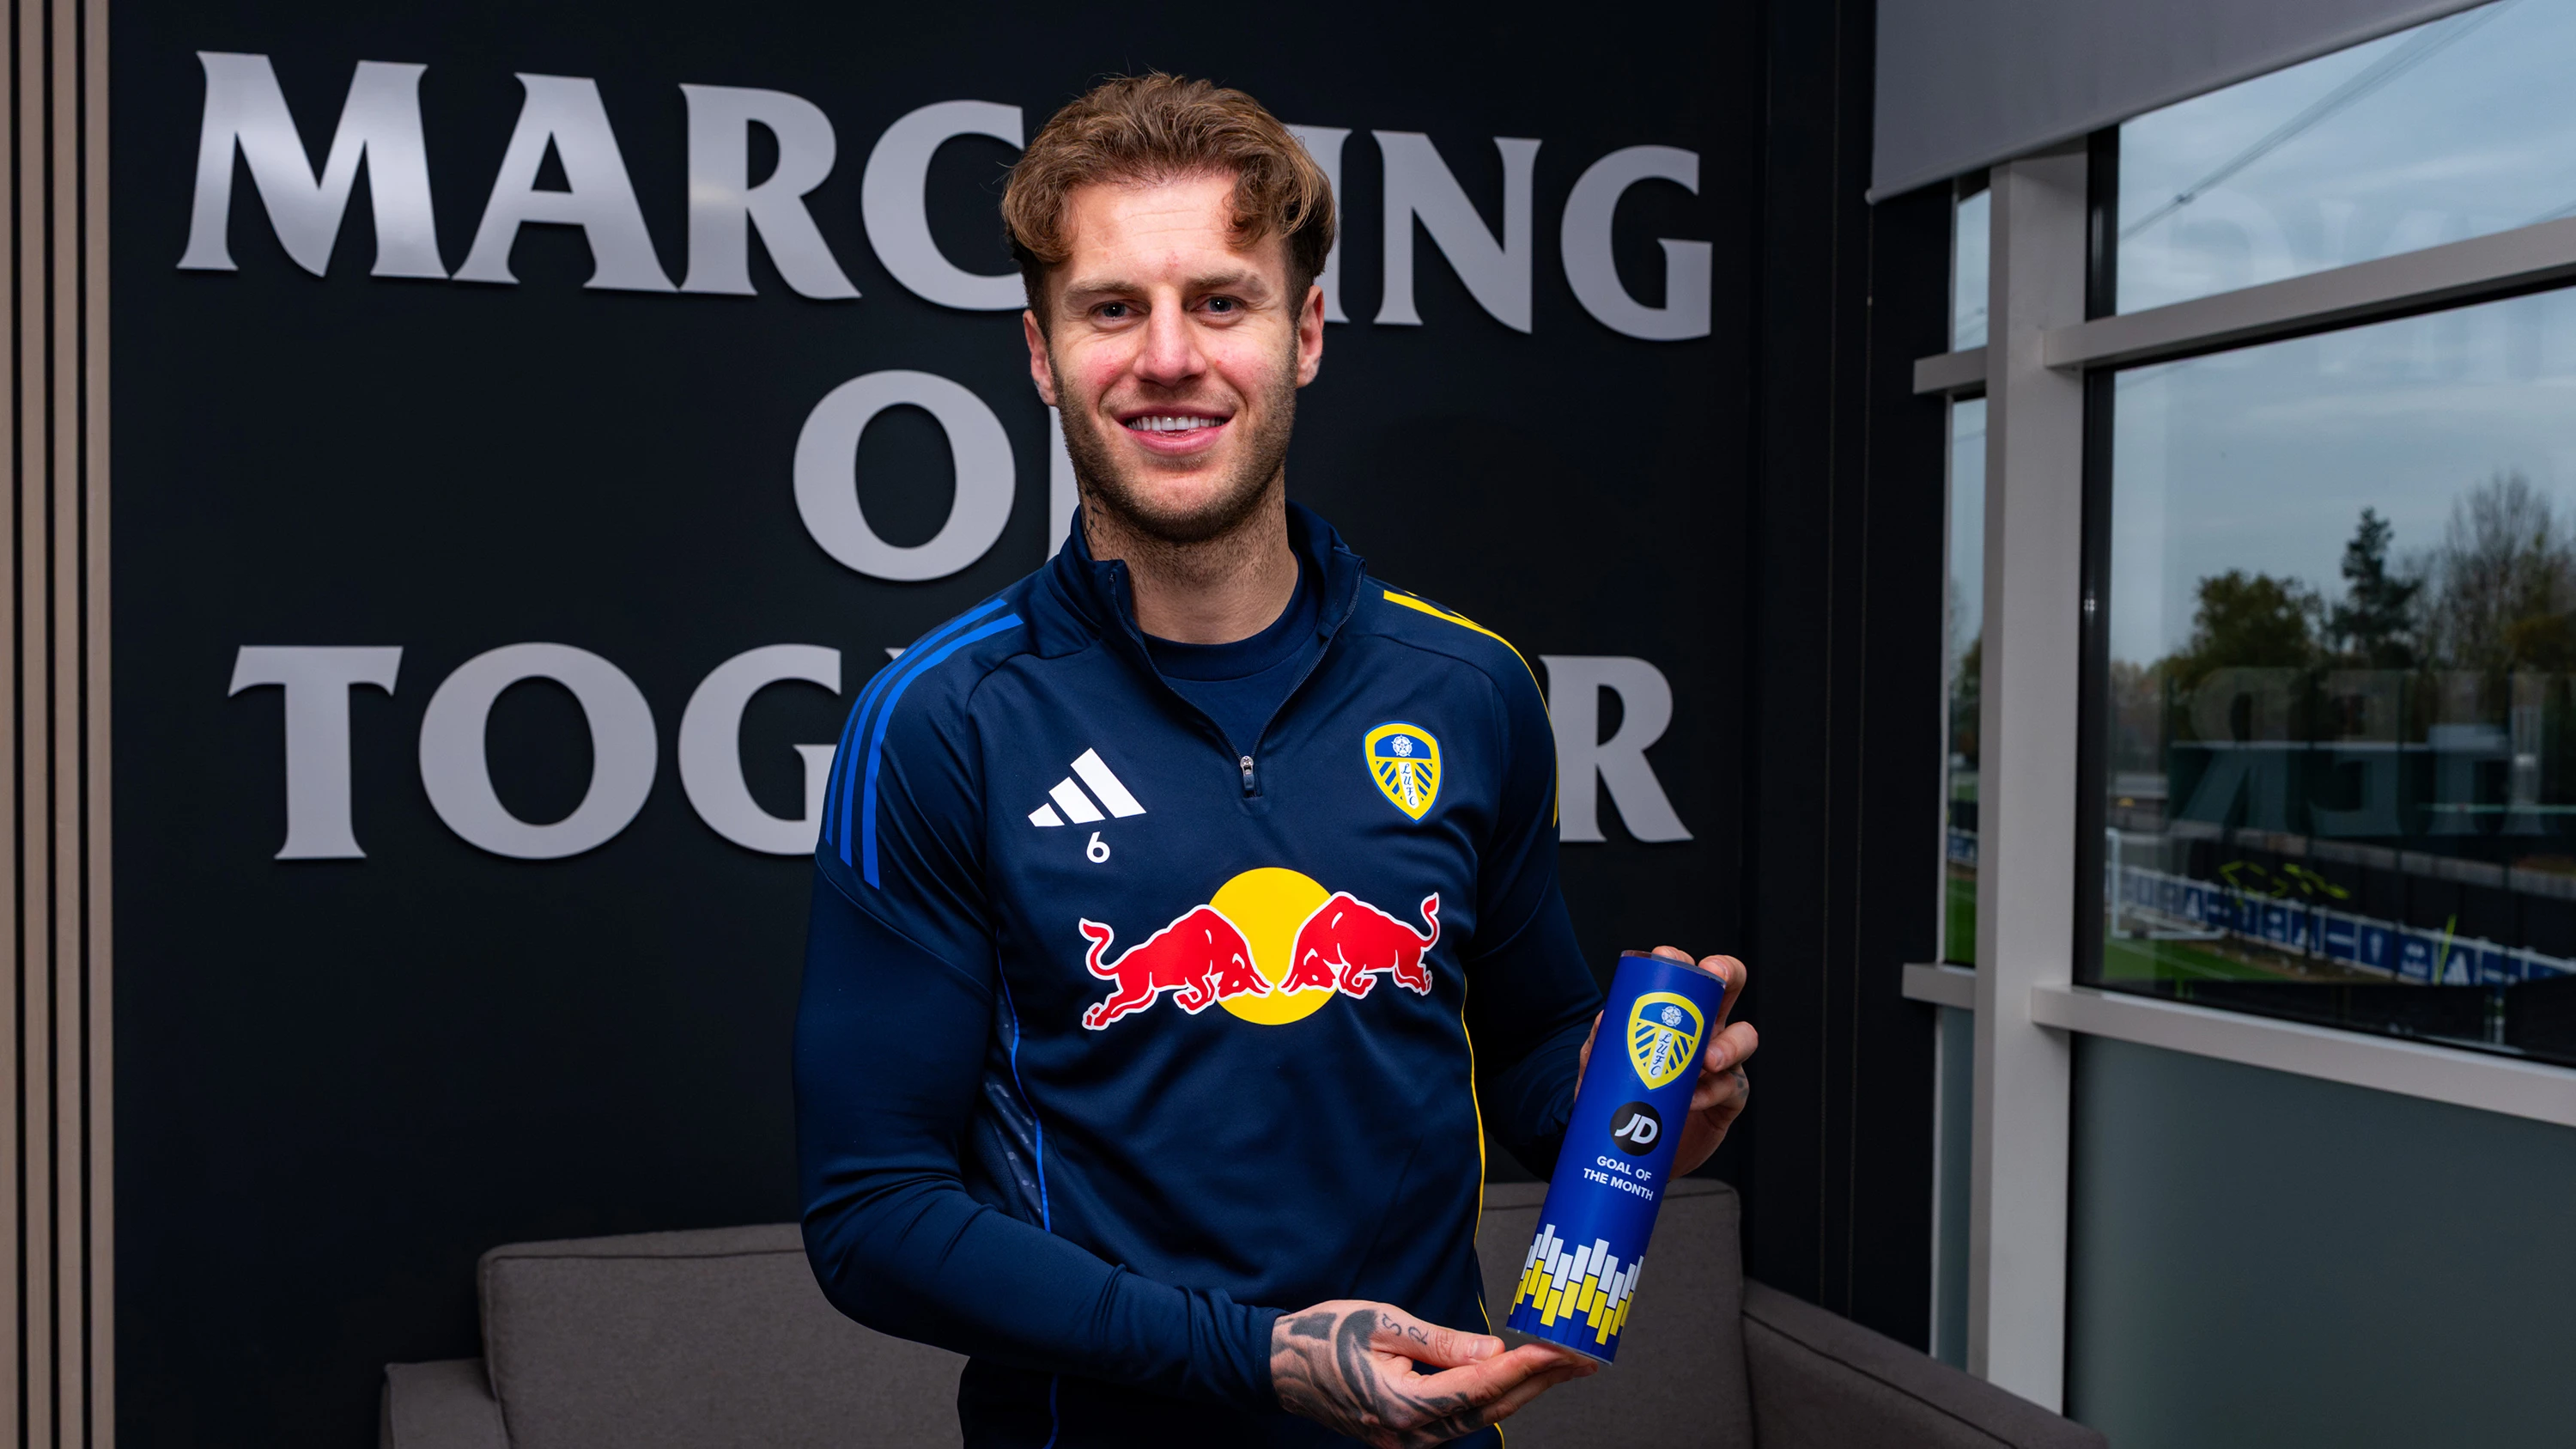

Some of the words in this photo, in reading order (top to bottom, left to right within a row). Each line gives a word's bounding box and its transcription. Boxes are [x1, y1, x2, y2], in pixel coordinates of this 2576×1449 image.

[176, 51, 1712, 341] MARCNG
[793, 369, 1078, 581] O
[228, 642, 1694, 860] TOGR
[1401, 763, 1417, 806] LUFC
[1086, 831, 1110, 863] 6
[1649, 1032, 1672, 1075] LUFC
[1614, 1113, 1658, 1144] JD
[1583, 1168, 1609, 1184] THE
[1610, 1176, 1654, 1201] MONTH
[1596, 1155, 1631, 1176] GOAL
[1635, 1169, 1652, 1181] OF
